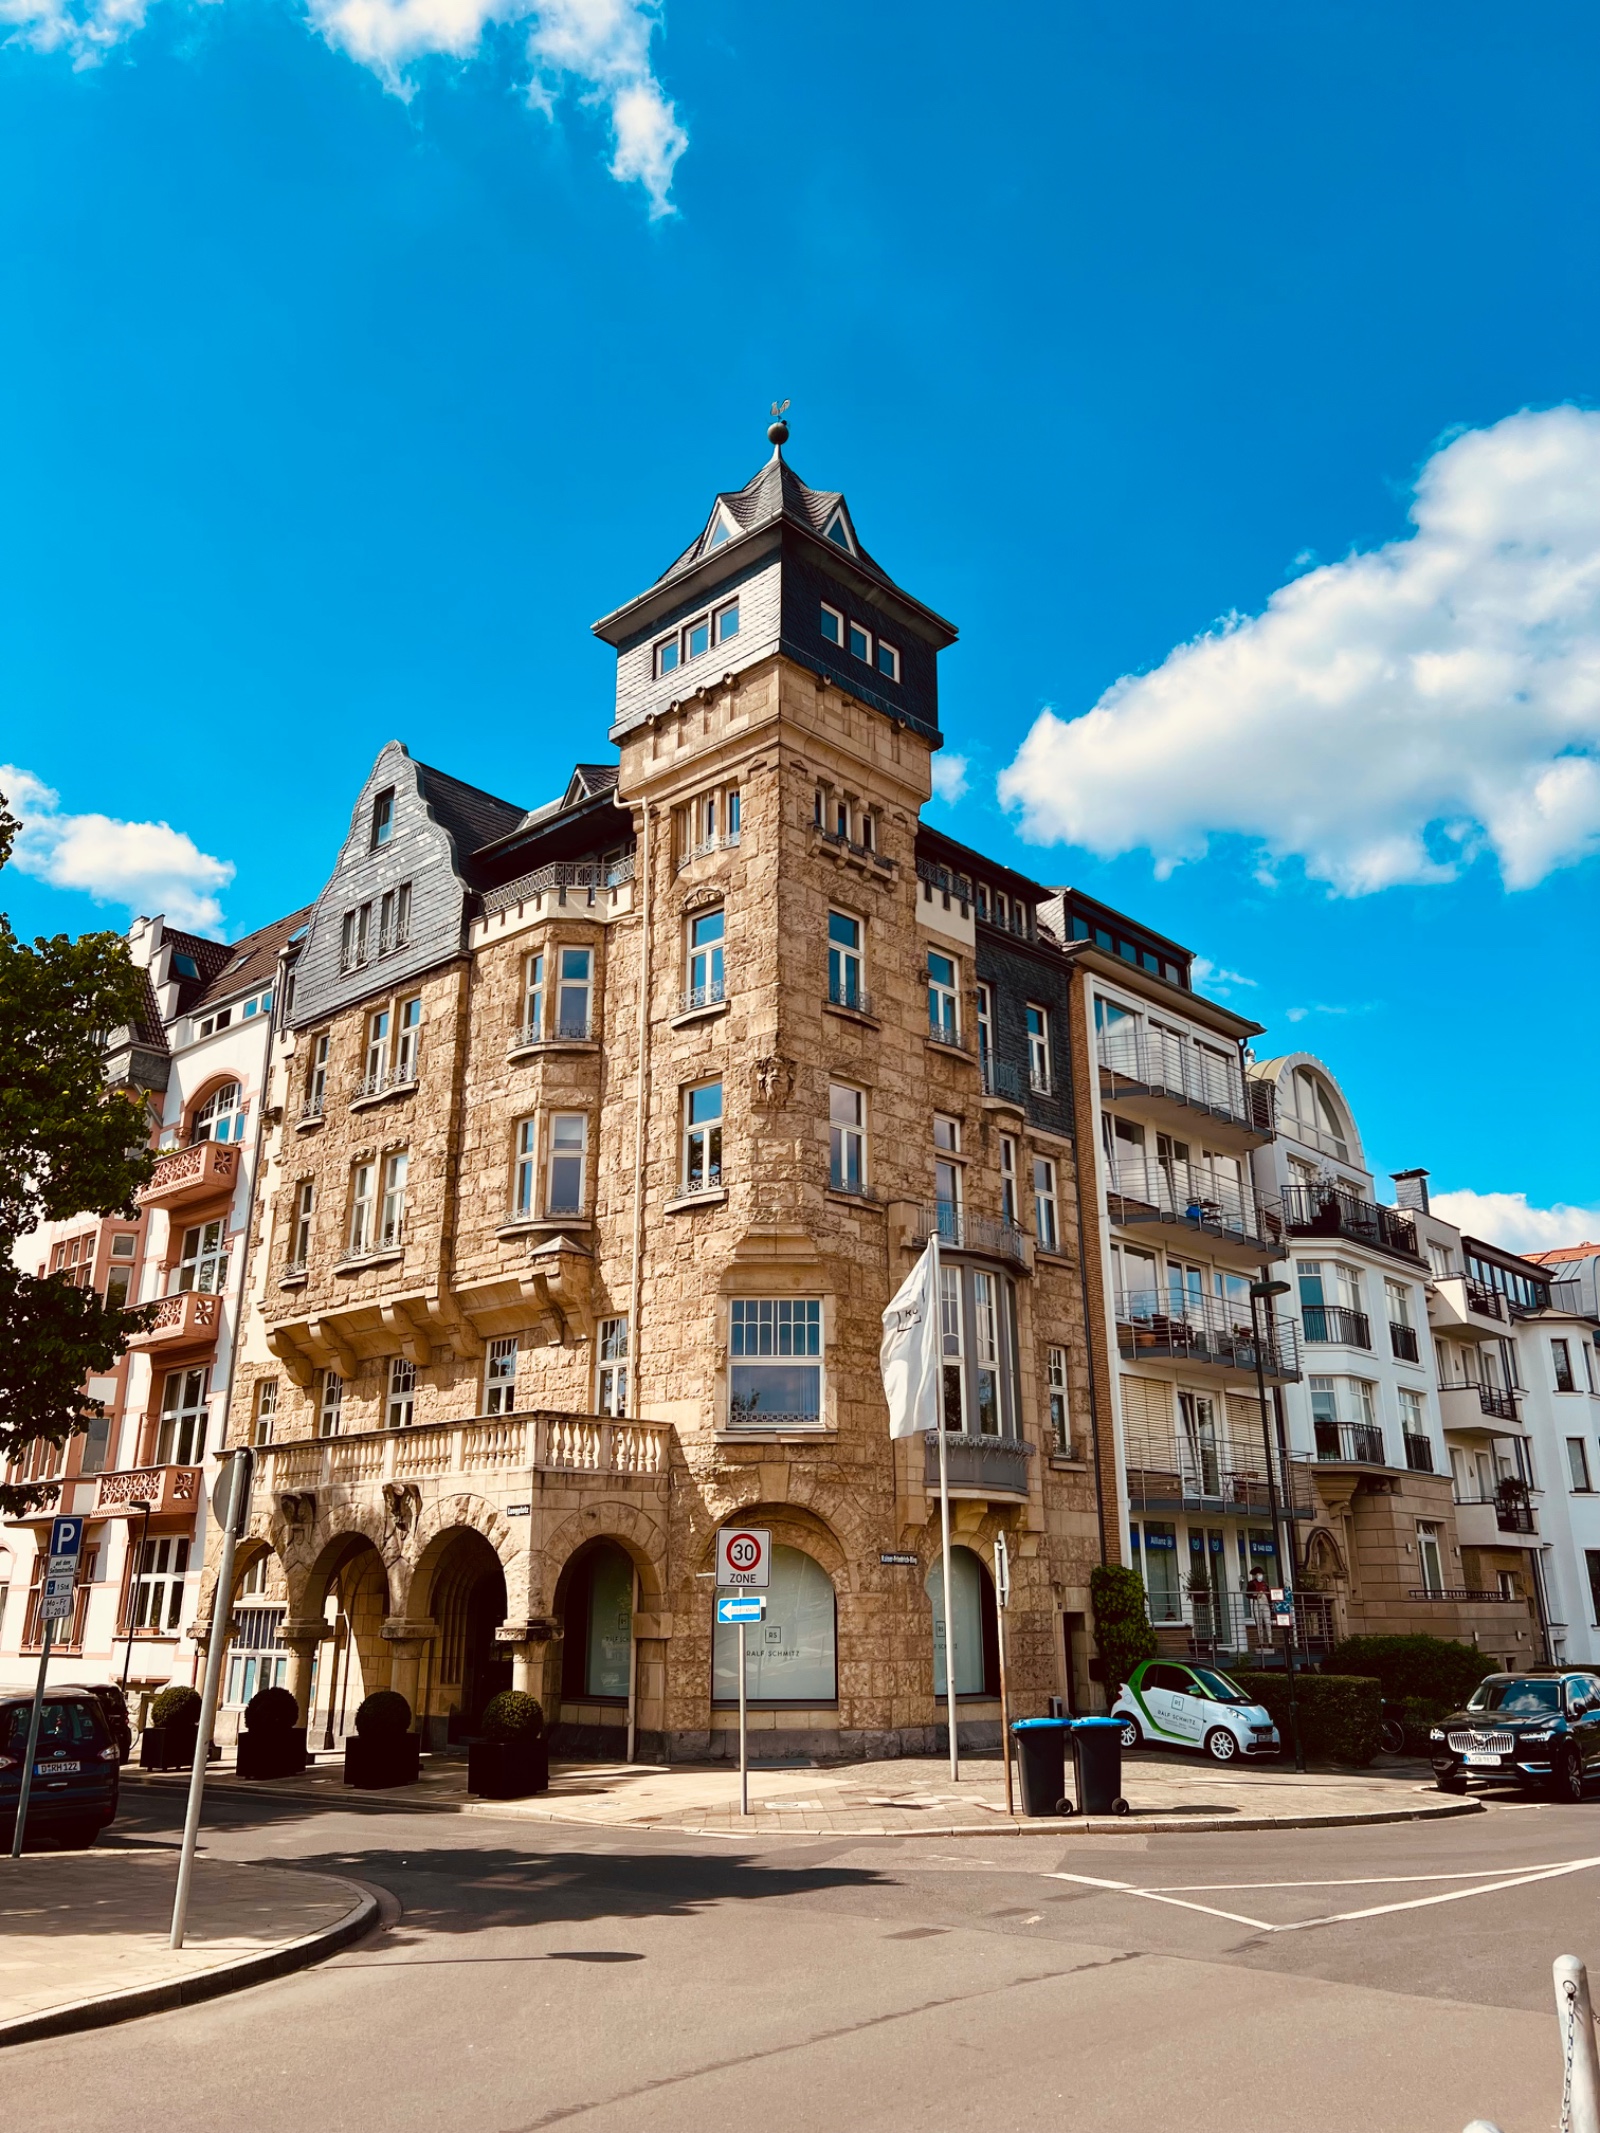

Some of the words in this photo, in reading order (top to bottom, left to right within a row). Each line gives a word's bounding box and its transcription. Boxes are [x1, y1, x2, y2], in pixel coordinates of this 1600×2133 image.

[57, 1523, 75, 1554] P
[1150, 1536, 1166, 1545] Allianz
[733, 1544, 754, 1561] 30
[730, 1573, 756, 1583] ZONE
[768, 1631, 778, 1639] RS
[63, 1762, 77, 1770] 122
